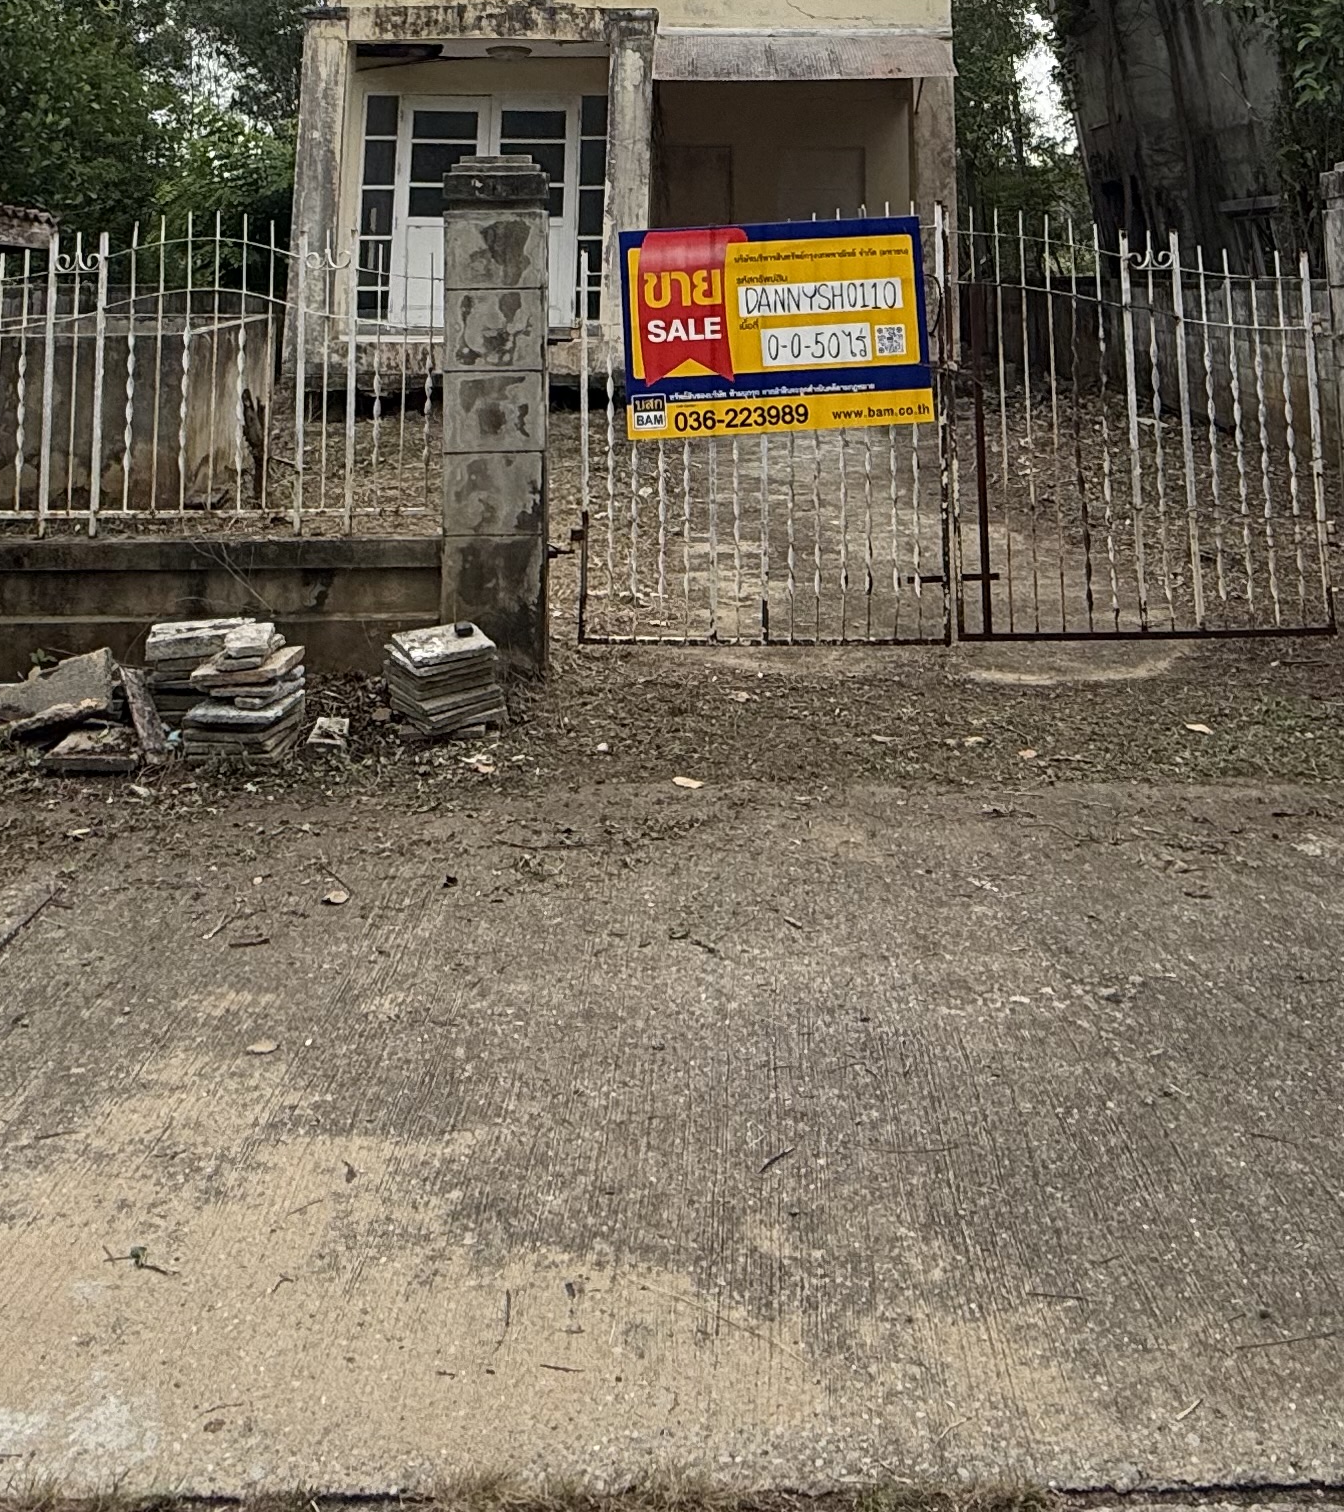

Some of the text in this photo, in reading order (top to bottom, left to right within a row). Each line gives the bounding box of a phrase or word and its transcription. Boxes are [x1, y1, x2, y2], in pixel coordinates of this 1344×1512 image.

[644, 269, 722, 308] ขาย
[745, 281, 897, 314] DANNYSH0110
[647, 317, 722, 343] SALE
[635, 398, 662, 411] บสก
[674, 403, 809, 432] 036-223989
[832, 403, 930, 420] www.bam.co.th
[636, 414, 664, 427] BAM
